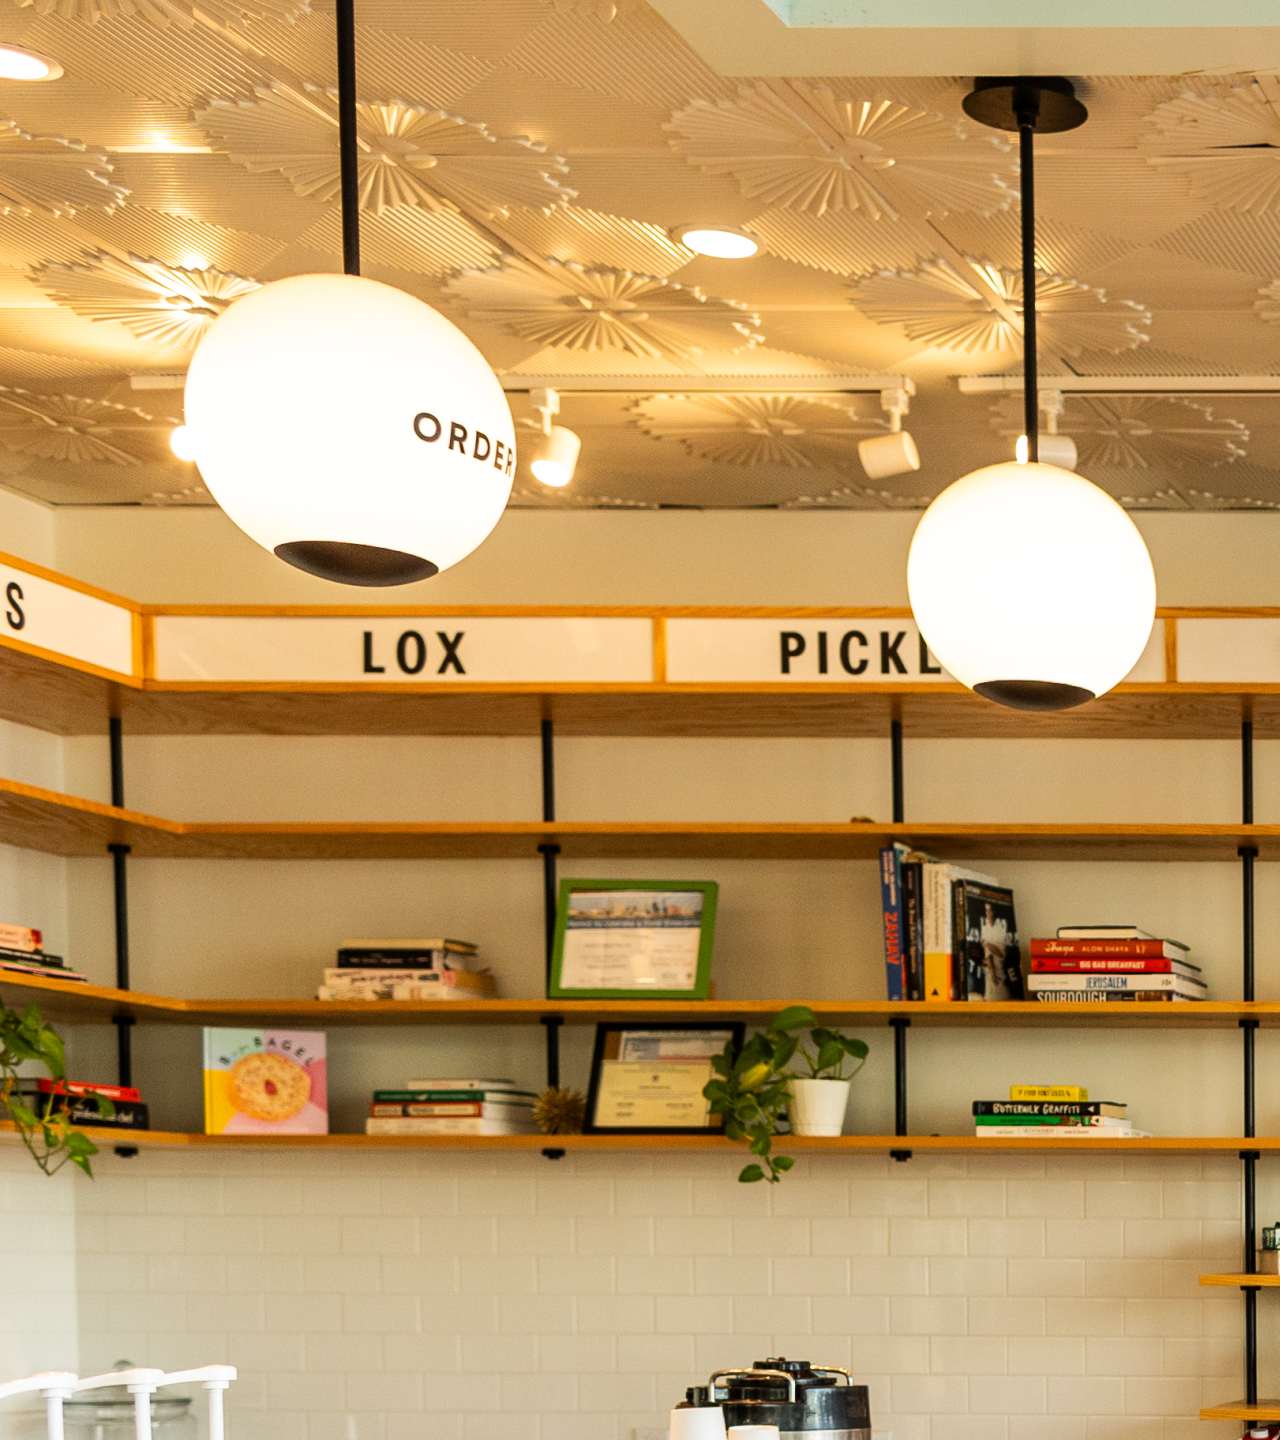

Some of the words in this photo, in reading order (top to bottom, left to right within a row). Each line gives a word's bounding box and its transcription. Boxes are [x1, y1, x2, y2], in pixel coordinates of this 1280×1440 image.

[413, 412, 513, 477] ORDER
[361, 630, 467, 676] LOX
[780, 630, 942, 676] PICKL
[1037, 991, 1106, 1002] SOURDOUGH
[1086, 977, 1127, 988] JERUSALEM
